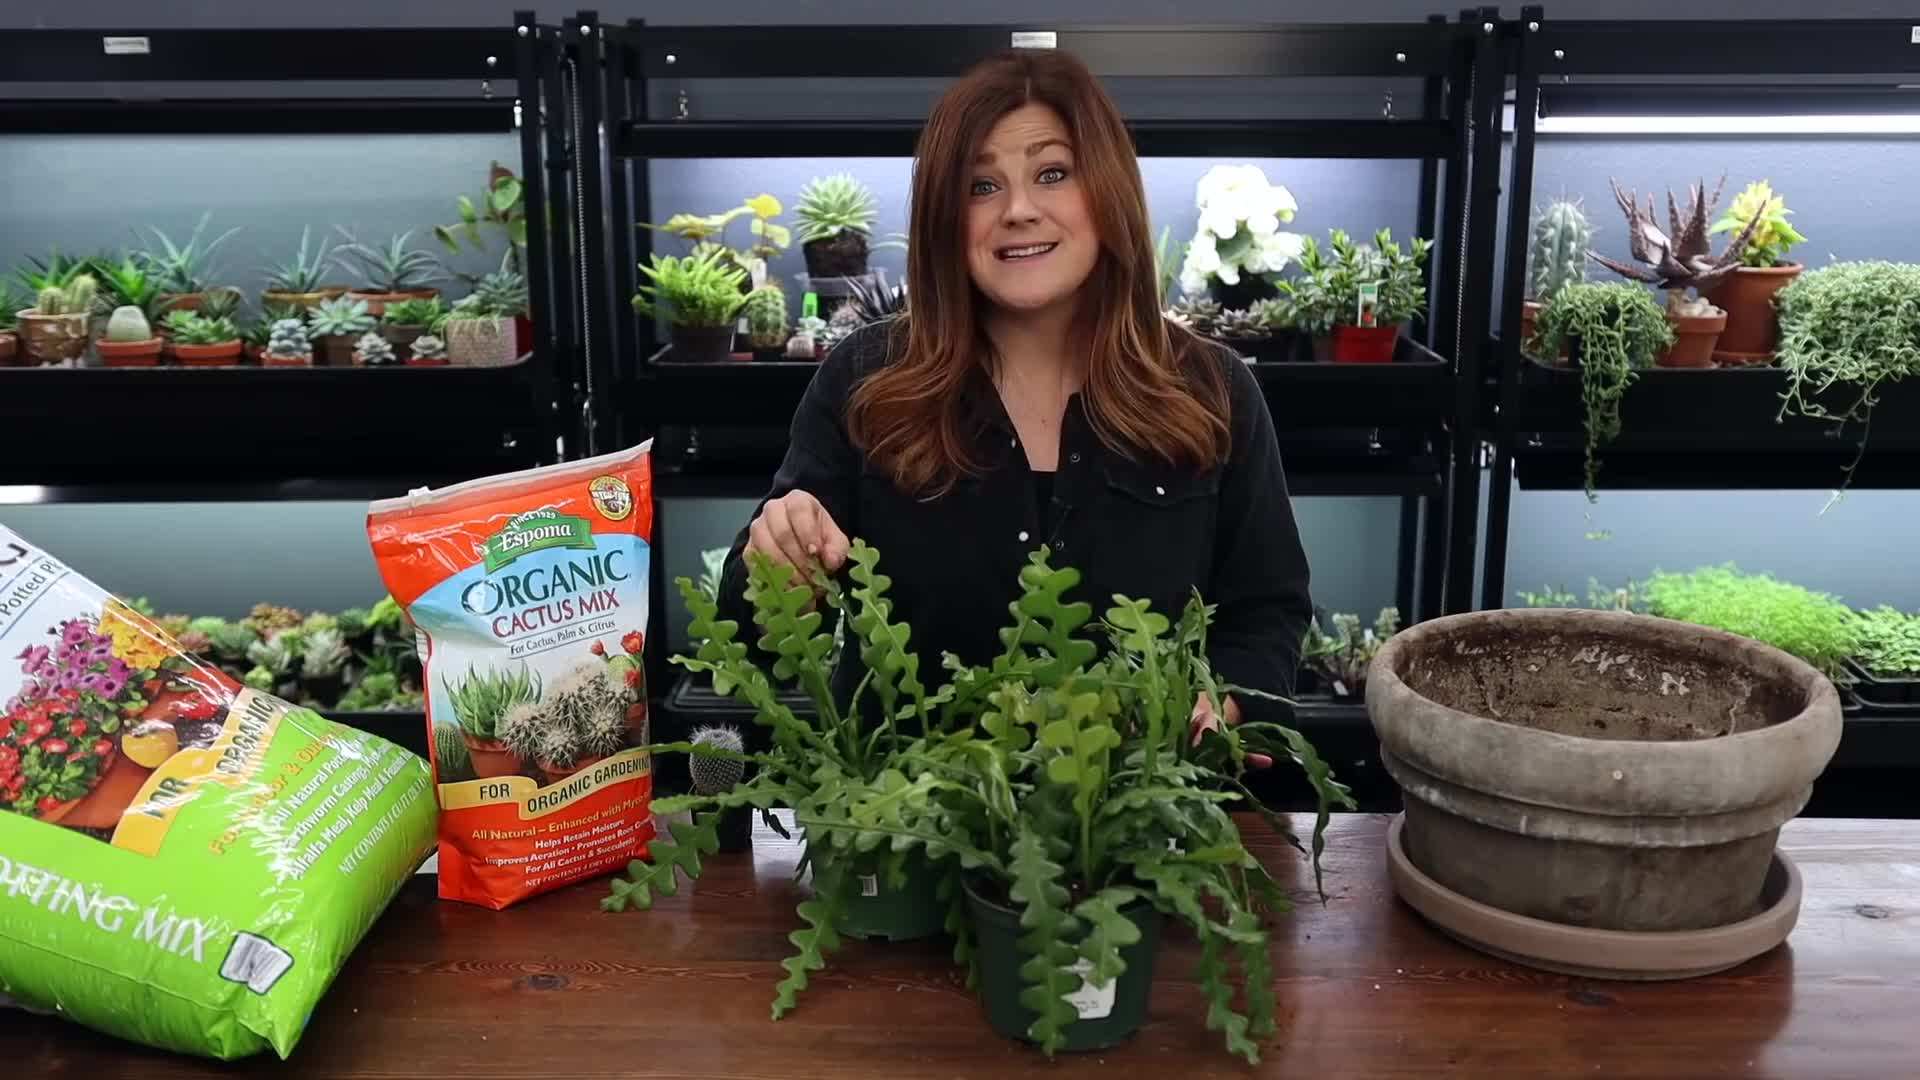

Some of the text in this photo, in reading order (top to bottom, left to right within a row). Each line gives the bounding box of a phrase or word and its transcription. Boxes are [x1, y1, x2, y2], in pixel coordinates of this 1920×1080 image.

[502, 524, 571, 551] Espoma
[0, 571, 47, 616] Potted
[461, 550, 628, 616] ORGANIC
[493, 588, 620, 637] CACTUS MIX
[510, 620, 616, 655] For Cactus, Palm & Citrus
[288, 770, 329, 808] Natural
[479, 756, 649, 812] FOR ORGANIC GARDENIN
[472, 829, 487, 839] All
[490, 827, 536, 840] Natural
[549, 813, 599, 834] Enhanced
[602, 804, 621, 818] with
[535, 838, 561, 850] Helps
[563, 829, 591, 844] Retain
[592, 820, 625, 834] Moisture
[485, 855, 529, 867] Improves
[530, 847, 570, 861] Aeration
[577, 834, 616, 850] Promotes
[525, 864, 542, 874] For
[558, 854, 586, 867] Cactus
[132, 905, 217, 962] MIX
